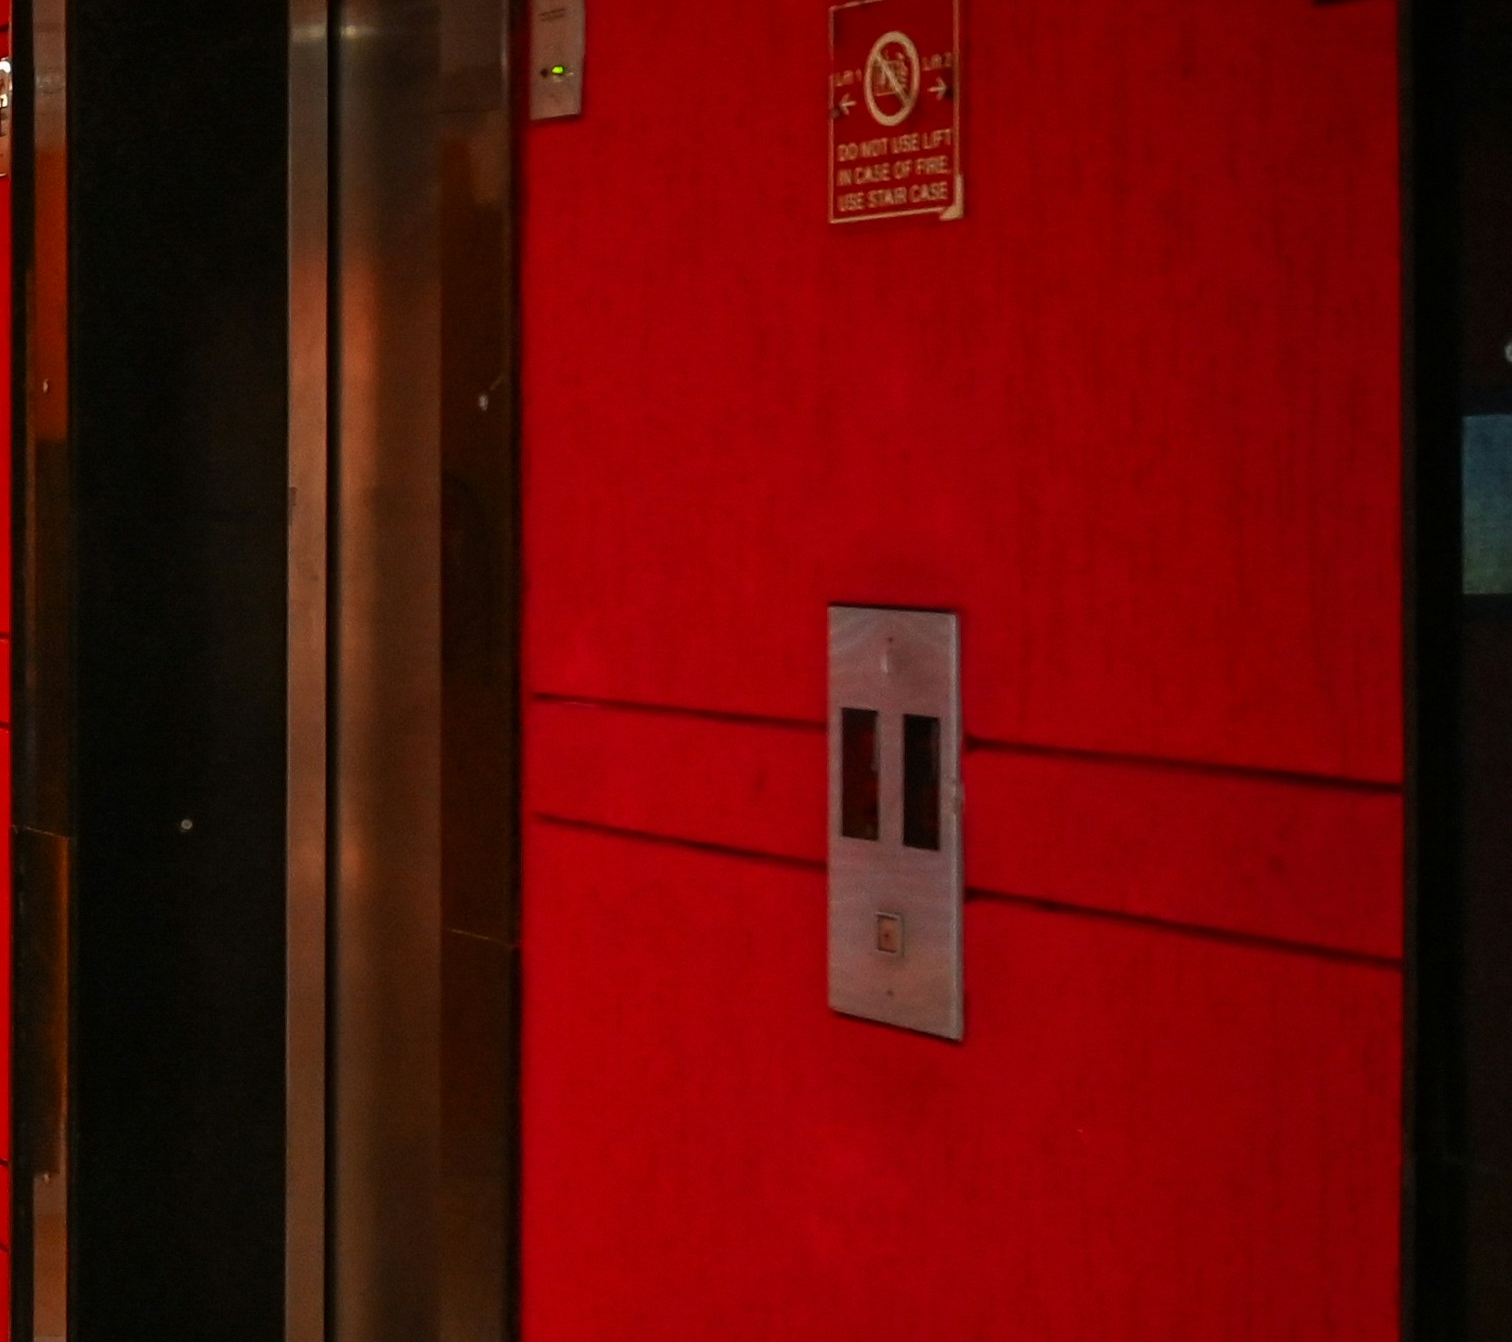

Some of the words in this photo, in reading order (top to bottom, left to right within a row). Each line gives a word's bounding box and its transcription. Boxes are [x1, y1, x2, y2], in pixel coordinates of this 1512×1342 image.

[837, 143, 858, 162] DO
[859, 138, 888, 158] NOT
[890, 133, 920, 154] USE
[922, 128, 951, 149] LIFT
[837, 168, 853, 186] IN
[854, 162, 891, 185] CASE
[892, 160, 912, 180] OF
[837, 192, 864, 212] USE
[867, 187, 907, 208] STAIR
[909, 181, 948, 203] CASE
